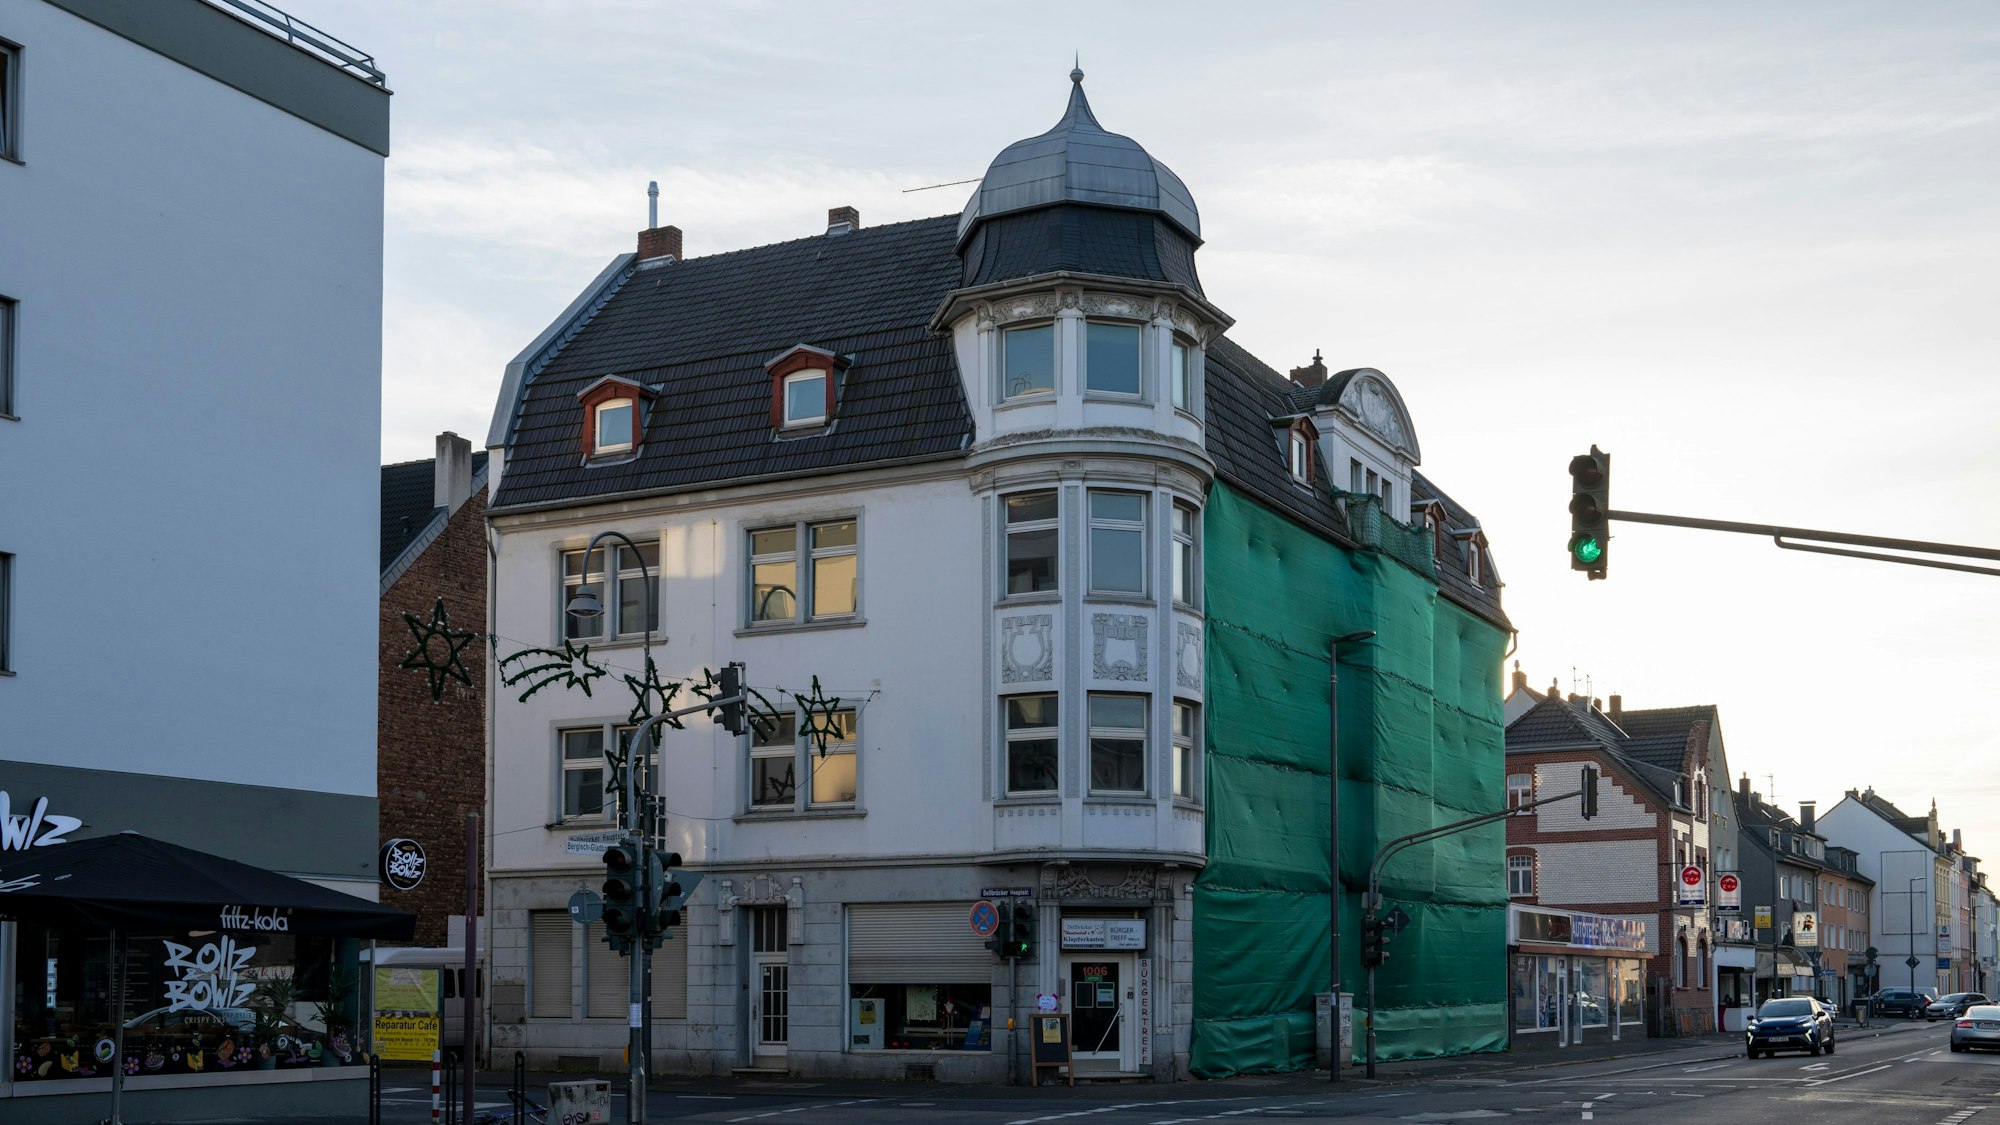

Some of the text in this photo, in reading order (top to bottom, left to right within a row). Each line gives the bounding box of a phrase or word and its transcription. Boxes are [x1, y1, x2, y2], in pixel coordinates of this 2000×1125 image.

[983, 889, 1008, 897] Dellbrücker
[220, 904, 289, 931] fritz-kola
[1083, 966, 1108, 976] 1006
[184, 1016, 210, 1024] CRISPY
[376, 1020, 438, 1031] Reparatur Café
